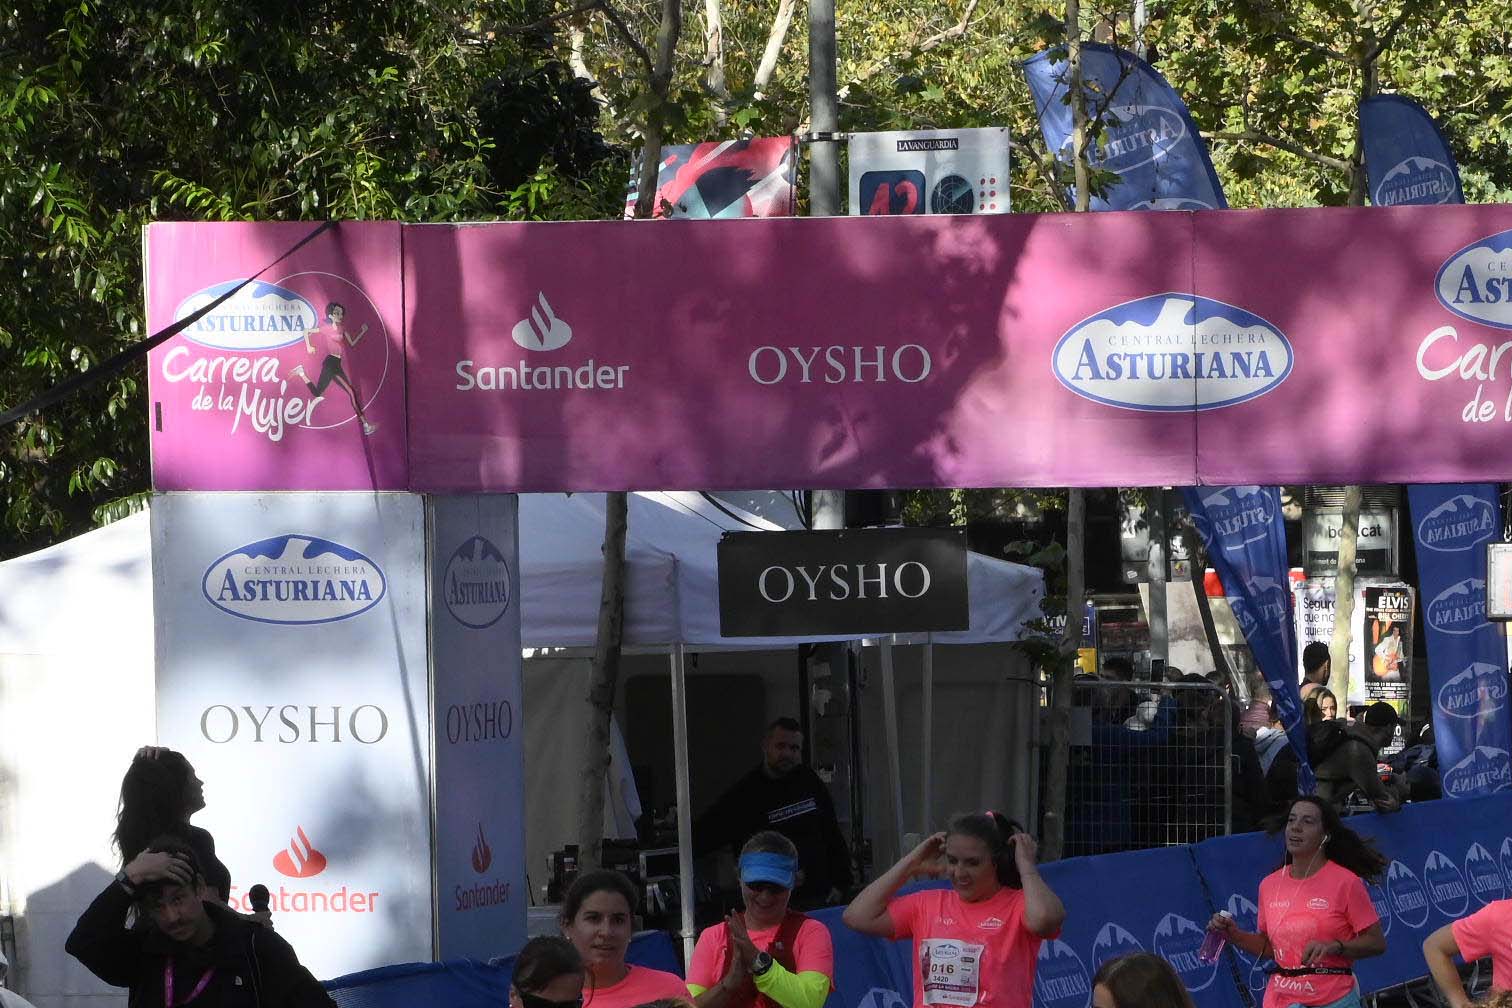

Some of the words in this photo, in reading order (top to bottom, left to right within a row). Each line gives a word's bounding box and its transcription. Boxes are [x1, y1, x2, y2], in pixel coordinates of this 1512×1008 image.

[897, 140, 908, 150] LA
[908, 138, 958, 150] VANGUARDIA
[1108, 334, 1183, 346] CENTRAL
[1191, 332, 1267, 345] LECHERA
[162, 346, 280, 383] Carrera
[456, 360, 630, 391] Santander
[748, 344, 932, 384] OYSHO
[1071, 337, 1275, 382] ASTURIANA
[192, 385, 213, 411] de
[217, 384, 234, 411] la
[231, 379, 325, 441] Mujer
[1462, 384, 1497, 423] de
[217, 568, 372, 601] ASTURIANA
[244, 566, 303, 575] CENTRAL
[308, 565, 367, 574] LECHERA
[758, 561, 932, 602] OYSHO
[449, 573, 506, 606] ASTURIANA
[1378, 596, 1409, 608] ELVIS
[200, 704, 389, 744] OYSHO
[446, 700, 512, 744] OYSHO
[455, 881, 510, 912] Santander
[931, 964, 954, 974] 016
[1274, 976, 1314, 992] SUMA
[1037, 974, 1088, 1001] ASTURIANA
